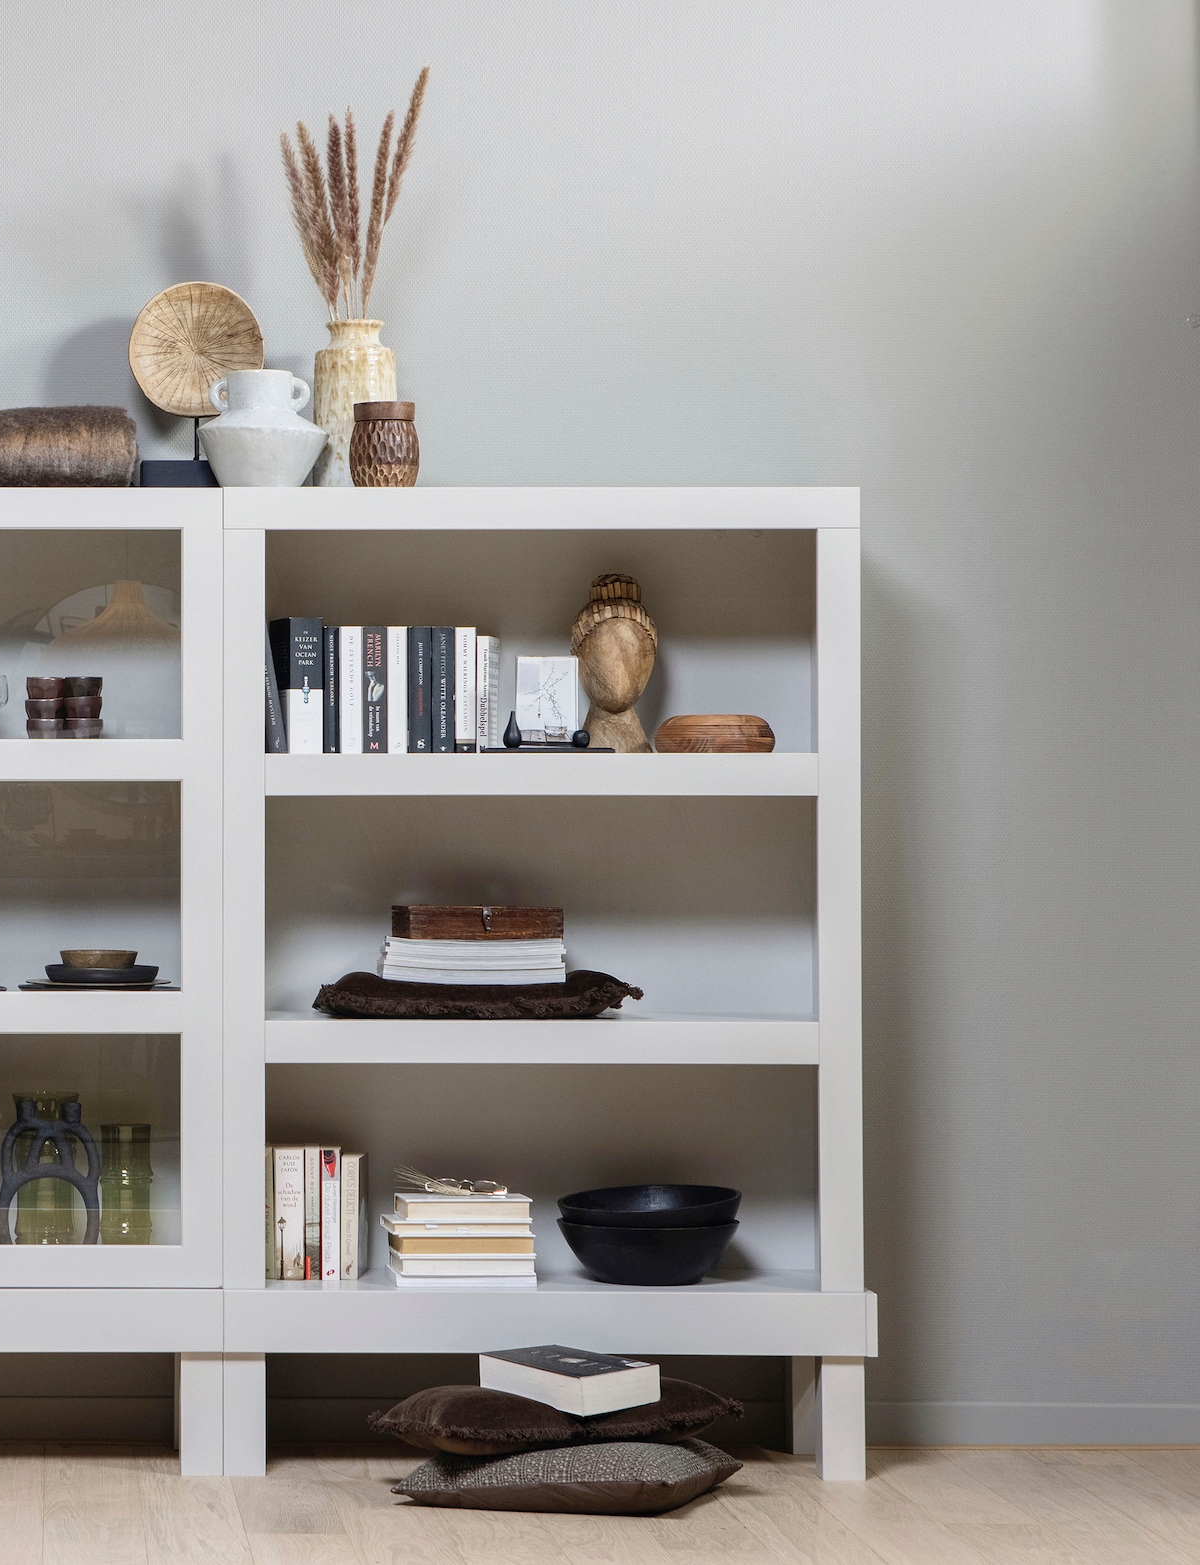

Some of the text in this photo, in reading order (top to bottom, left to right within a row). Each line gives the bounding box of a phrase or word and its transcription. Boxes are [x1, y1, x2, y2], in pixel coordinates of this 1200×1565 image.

[478, 697, 487, 737] Dubbelspel
[325, 1182, 332, 1193] De
[346, 1161, 356, 1215] CORPUS DELICTI
[324, 1218, 332, 1240] draagt
